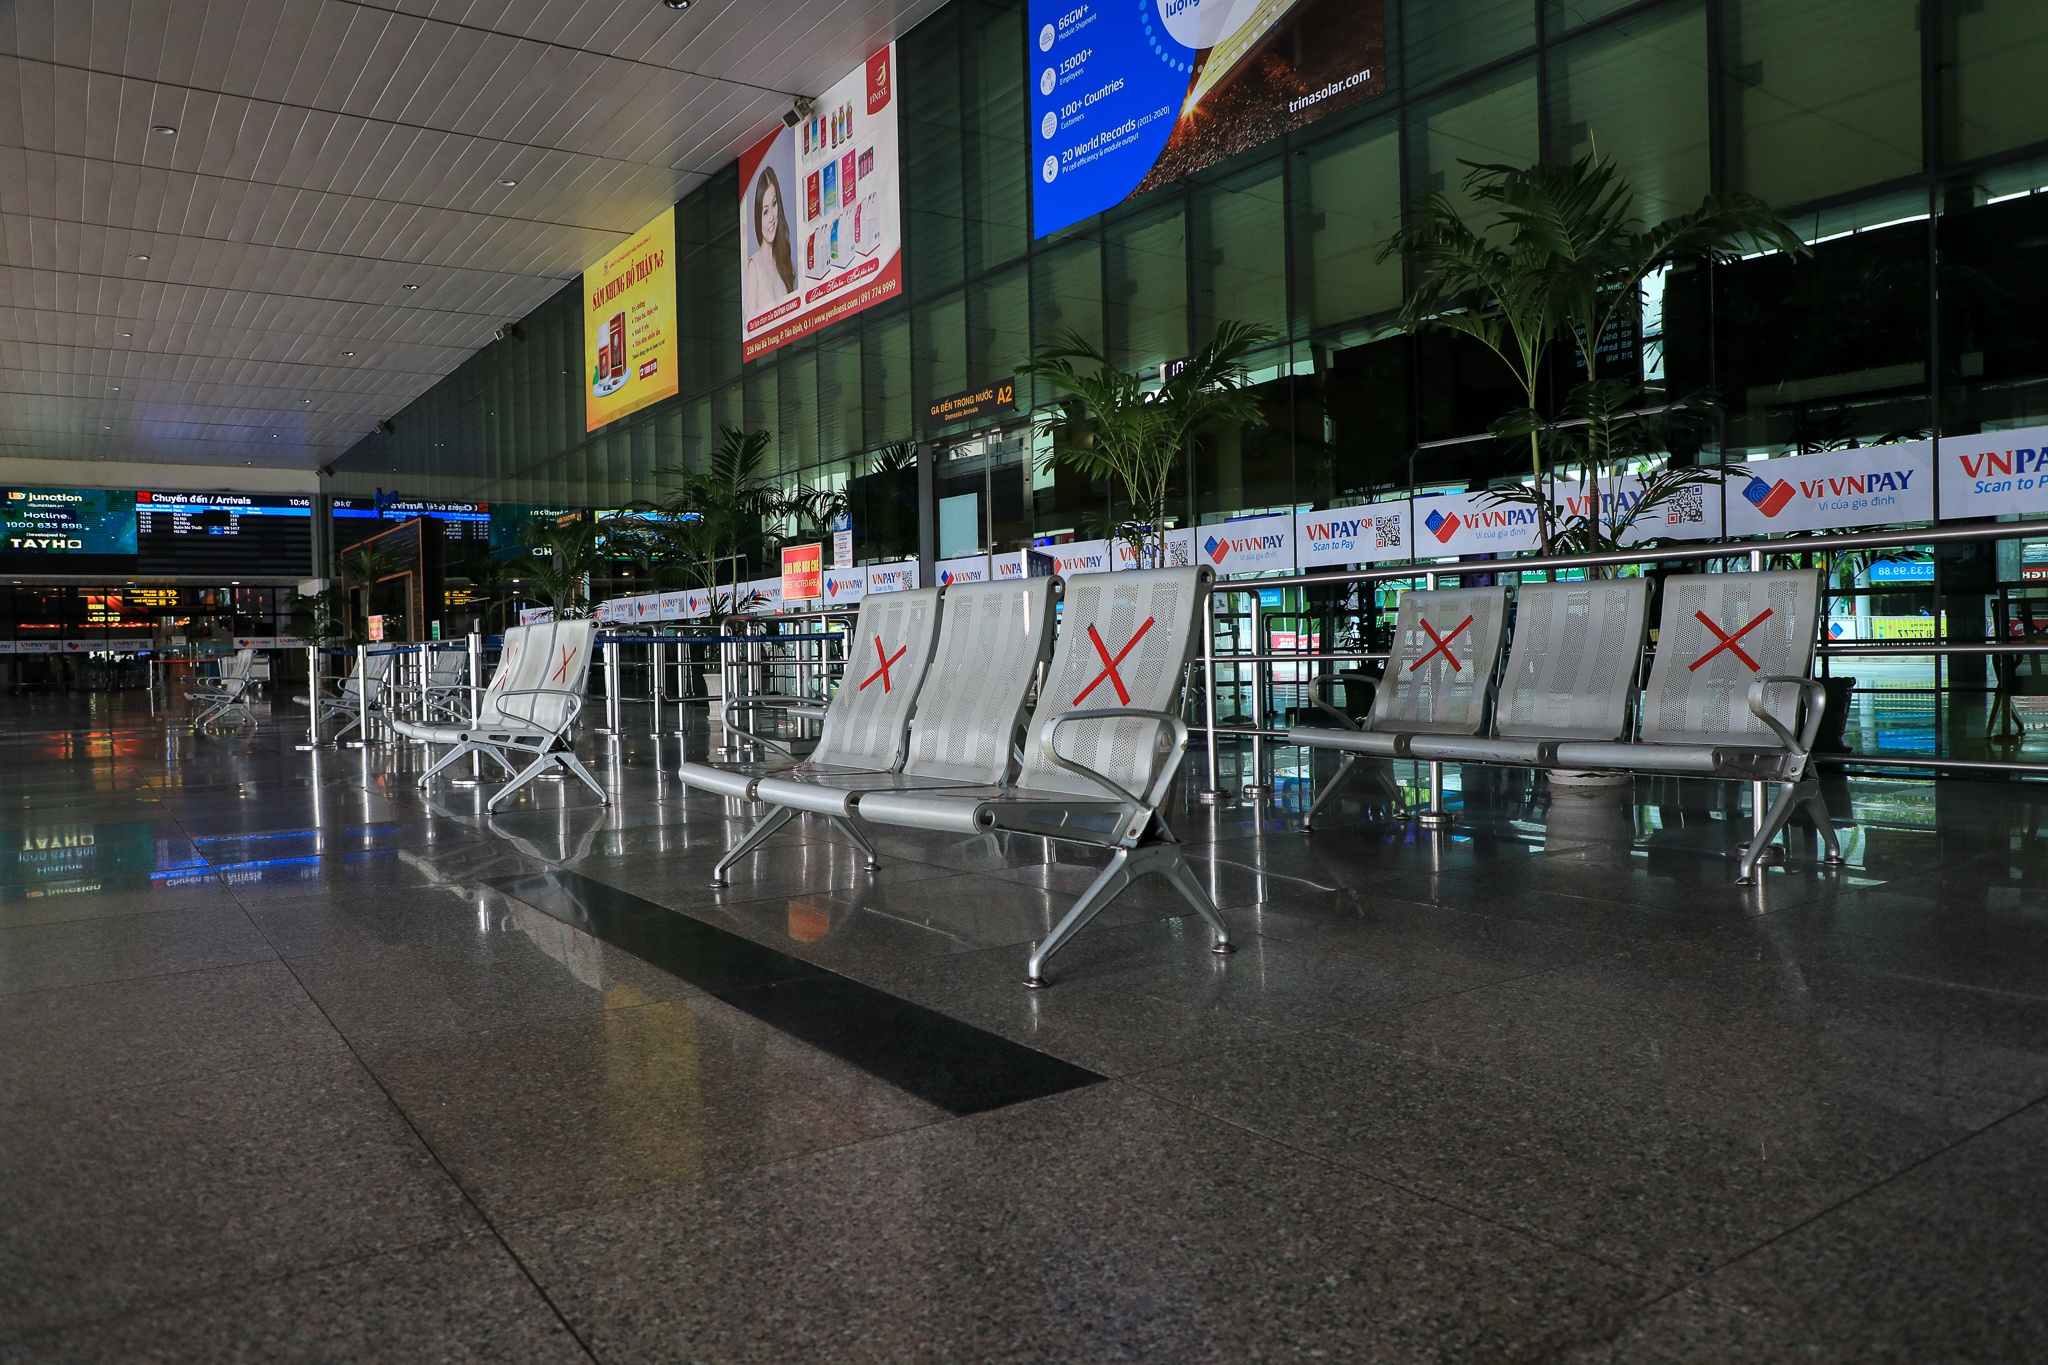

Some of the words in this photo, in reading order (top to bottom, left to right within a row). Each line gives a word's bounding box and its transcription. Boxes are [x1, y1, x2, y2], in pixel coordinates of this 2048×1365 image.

[1058, 4, 1089, 31] 66GW+
[1058, 27, 1075, 41] Module
[1075, 13, 1097, 32] Shipment
[1060, 48, 1093, 75] 15000+
[1060, 67, 1084, 86] Employees
[1060, 99, 1083, 120] 100+
[1084, 77, 1124, 107] Countries
[1288, 67, 1371, 114] trinasolar.com
[1060, 113, 1085, 130] Customers
[1061, 149, 1073, 164] 20
[1074, 134, 1099, 158] World
[1100, 119, 1136, 146] Records
[1137, 105, 1170, 129] (2011-2020)
[605, 272, 625, 304] NHUNG
[860, 289, 871, 303] 091
[871, 285, 882, 299] 774
[882, 278, 896, 294] 9999
[930, 405, 940, 416] GA
[940, 399, 953, 413] ĐẾN
[953, 395, 975, 409] TRONG
[975, 388, 993, 403] NƯỚC
[996, 385, 1013, 405] A2
[944, 410, 963, 421] Domestic
[963, 406, 979, 416] Arrivals
[1799, 479, 1824, 500] Ví
[1828, 468, 1915, 497] VNPAY
[1974, 480, 2012, 494] Scan
[2017, 477, 2034, 491] to
[28, 492, 83, 502] junction
[151, 493, 188, 504] Chuyến
[189, 494, 208, 504] đến
[215, 496, 252, 505] Arrivals
[289, 498, 310, 507] 10:46
[1830, 499, 1850, 510] của
[1852, 498, 1867, 511] gia
[1870, 495, 1895, 507] đình
[6, 521, 34, 529] 1900
[37, 522, 58, 530] 633
[61, 522, 83, 530] 898
[1462, 513, 1480, 529] Ví
[1483, 507, 1539, 528] VNPAY
[1484, 530, 1496, 538] của
[1498, 529, 1509, 540] gia
[1509, 527, 1526, 537] đình
[10, 538, 82, 549] TAYHO
[1231, 539, 1243, 553] Ví
[1246, 534, 1285, 551] VNPAY
[1313, 541, 1331, 552] Scan
[1331, 540, 1340, 550] to
[1341, 538, 1355, 550] Pay
[1062, 558, 1073, 570] Ví
[1073, 555, 1103, 569] VNPAY
[784, 579, 808, 589] RESTRICTED
[808, 578, 819, 587] AREA
[844, 579, 864, 589] VNPAY
[954, 573, 962, 582] Ví
[962, 570, 982, 581] VNPAY
